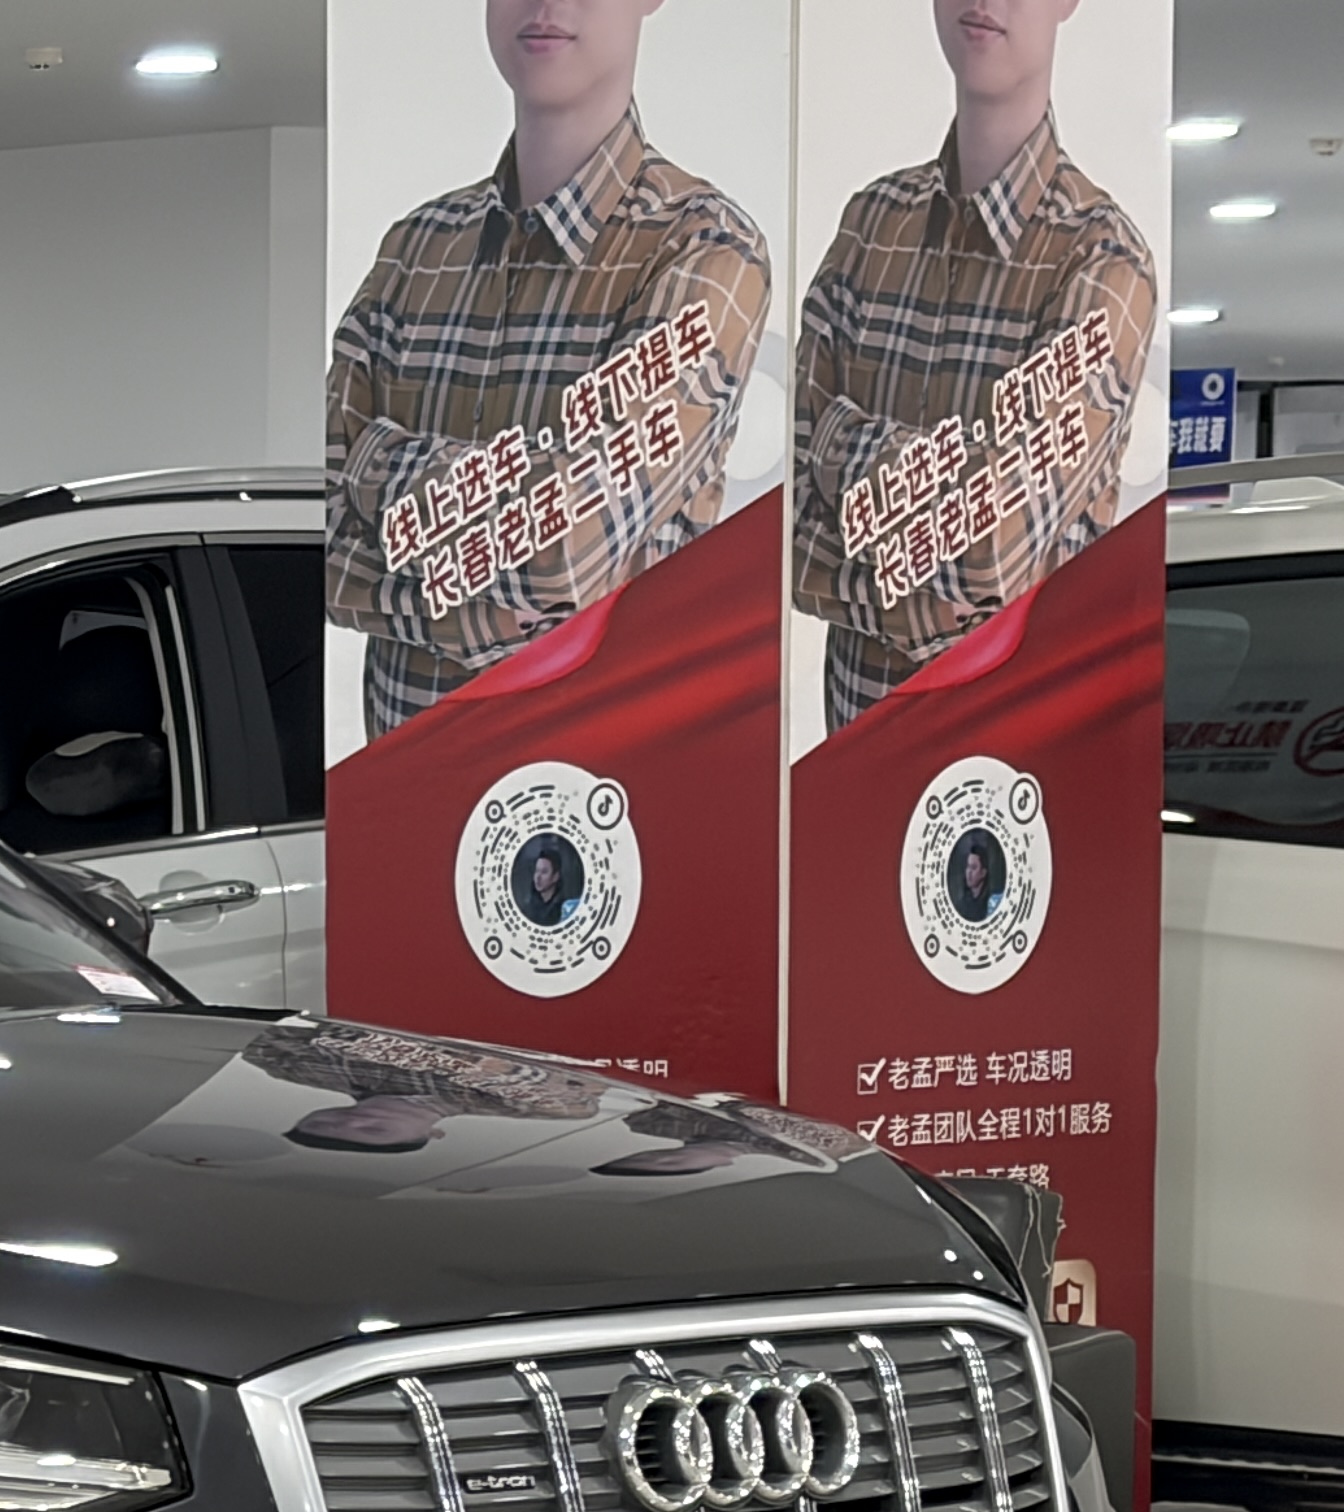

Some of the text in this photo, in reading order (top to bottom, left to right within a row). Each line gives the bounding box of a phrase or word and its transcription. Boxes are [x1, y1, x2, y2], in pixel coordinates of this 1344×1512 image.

[421, 399, 682, 620] 长春老孟二手车
[875, 402, 1088, 610] 长春老孟二手车
[887, 1048, 1073, 1090] 老孟严选 车况透明
[887, 1102, 1113, 1147] 老孟团队全程1对1服务
[466, 1475, 536, 1490] e-tron
